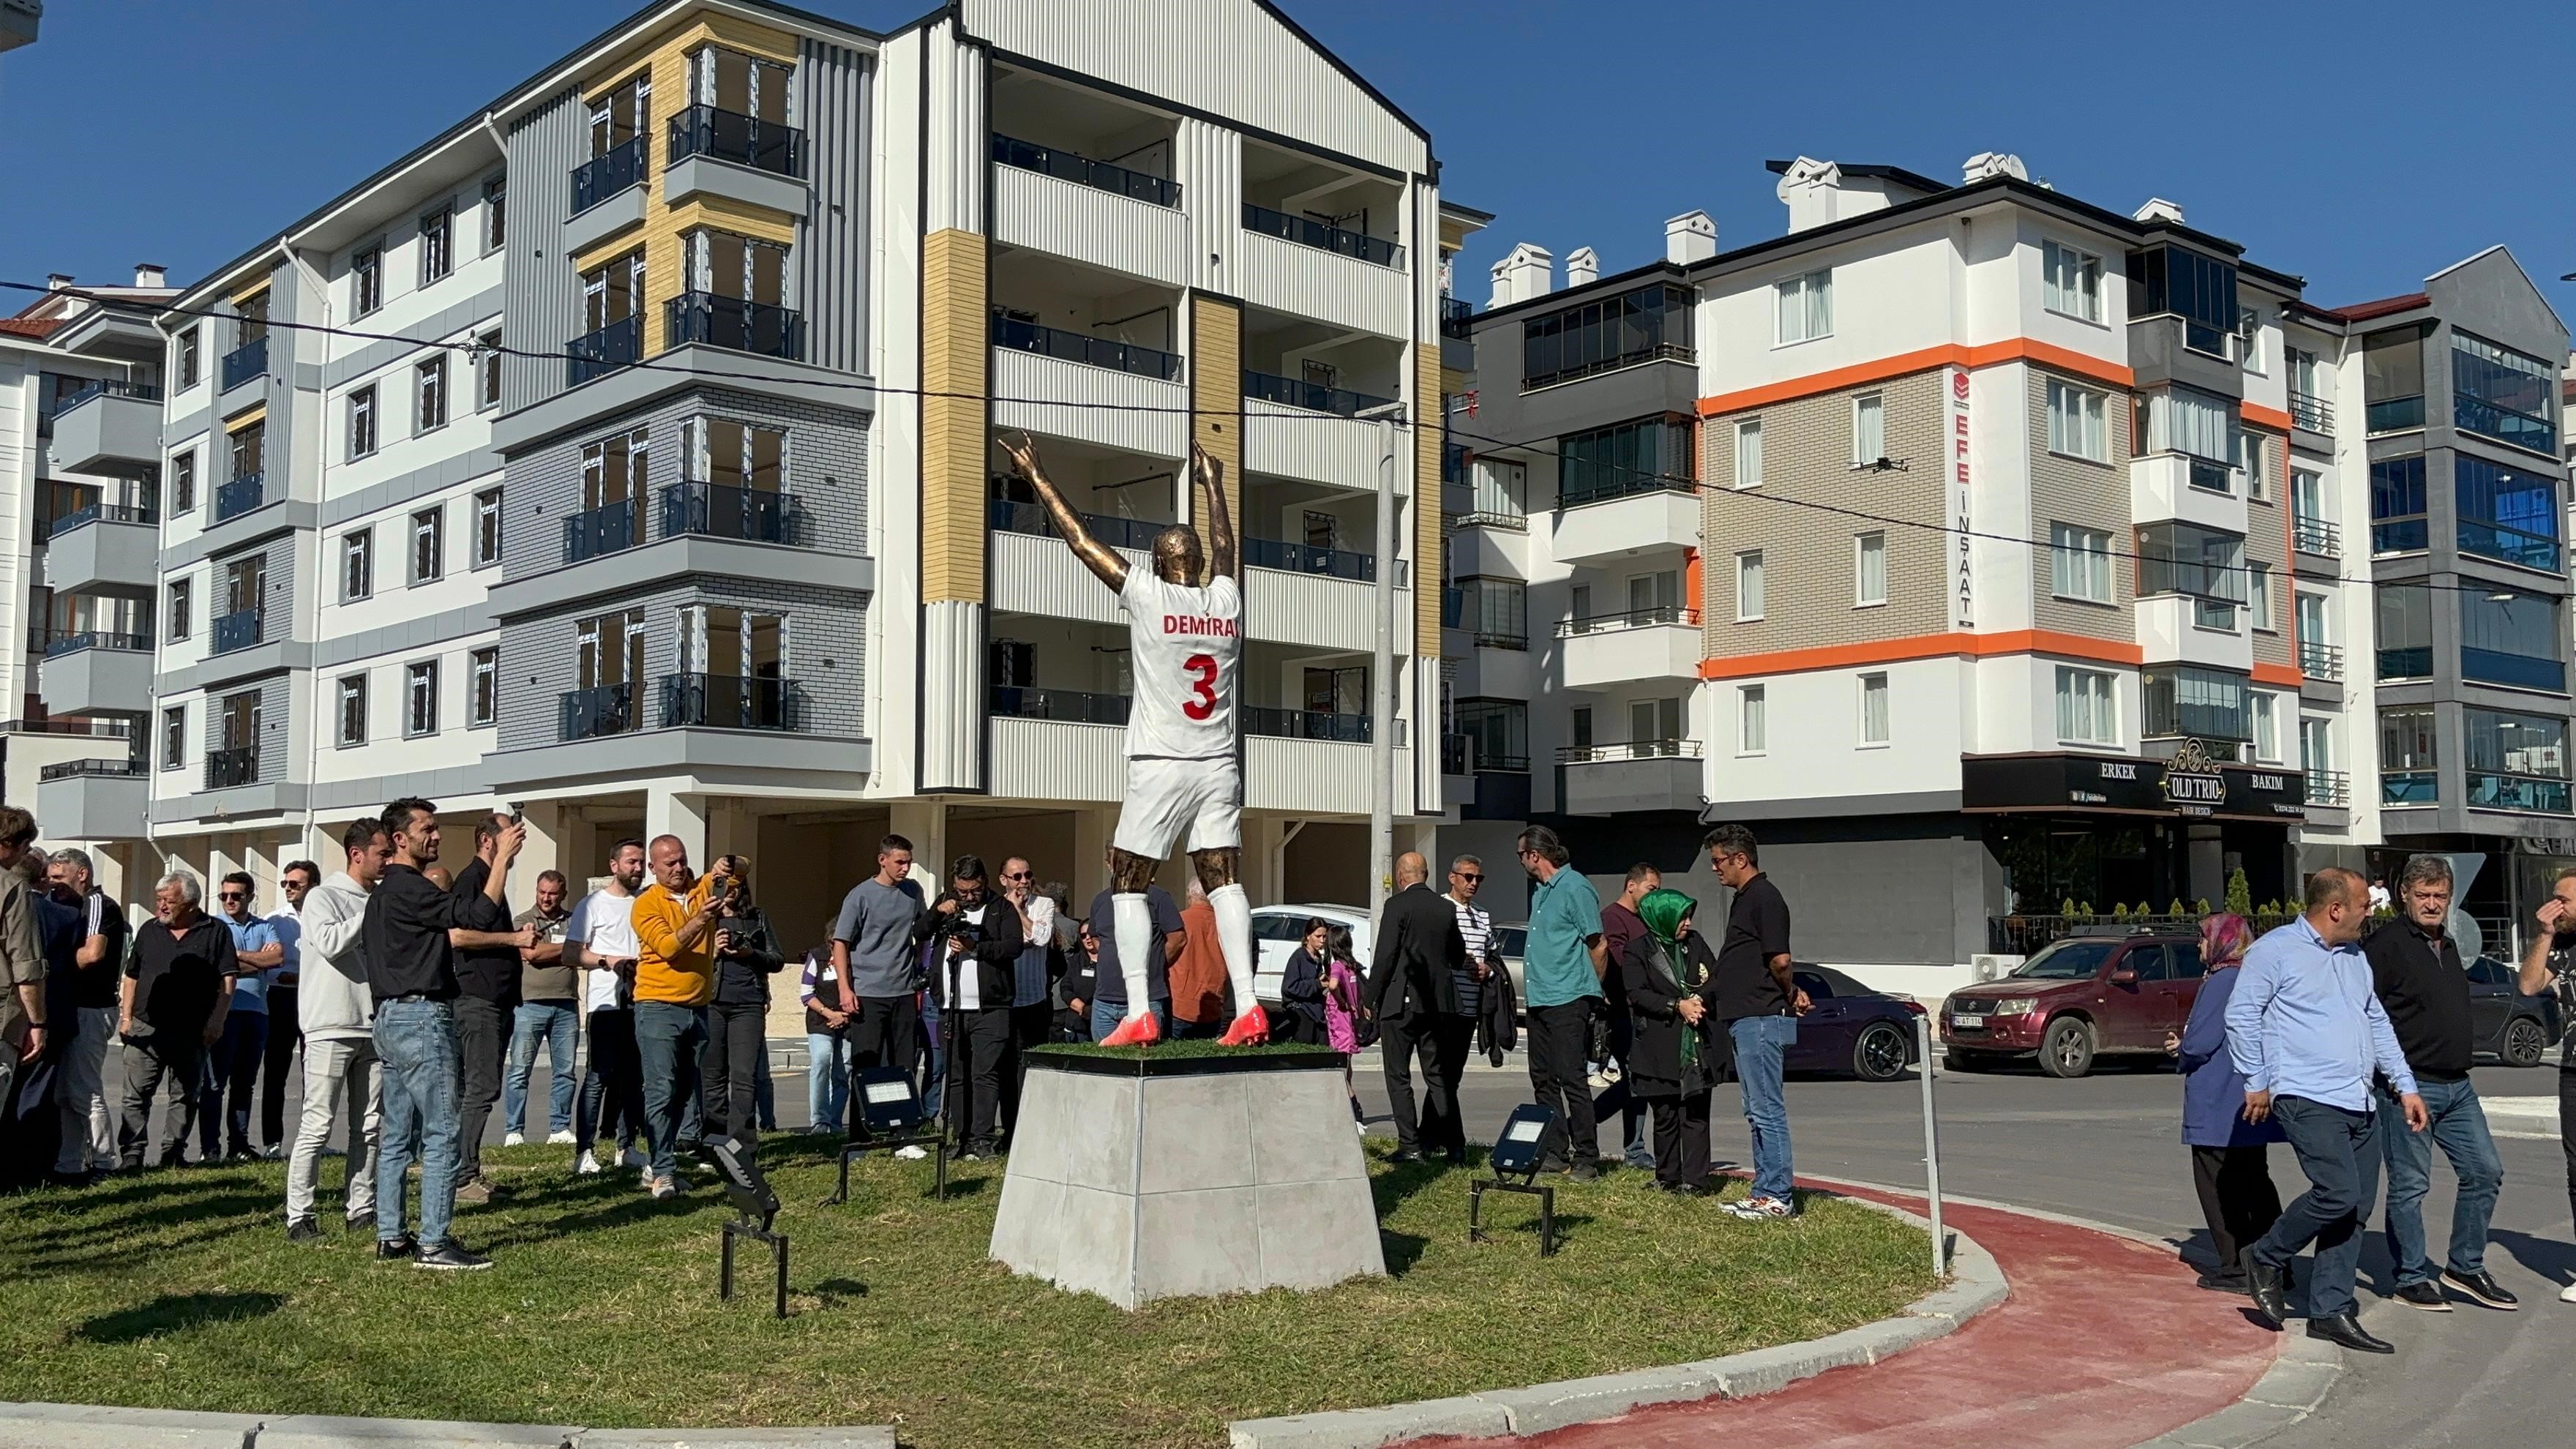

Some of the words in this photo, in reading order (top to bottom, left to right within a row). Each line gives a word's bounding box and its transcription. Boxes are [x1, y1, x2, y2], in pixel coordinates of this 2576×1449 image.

[1955, 414, 1969, 484] EFE
[1958, 490, 1972, 615] İNŞAAT
[1182, 654, 1218, 721] 3
[2101, 763, 2137, 780] ERKEK
[2172, 777, 2192, 798] OLD
[2193, 779, 2219, 799] TRIO
[2251, 774, 2283, 790] BAKIM
